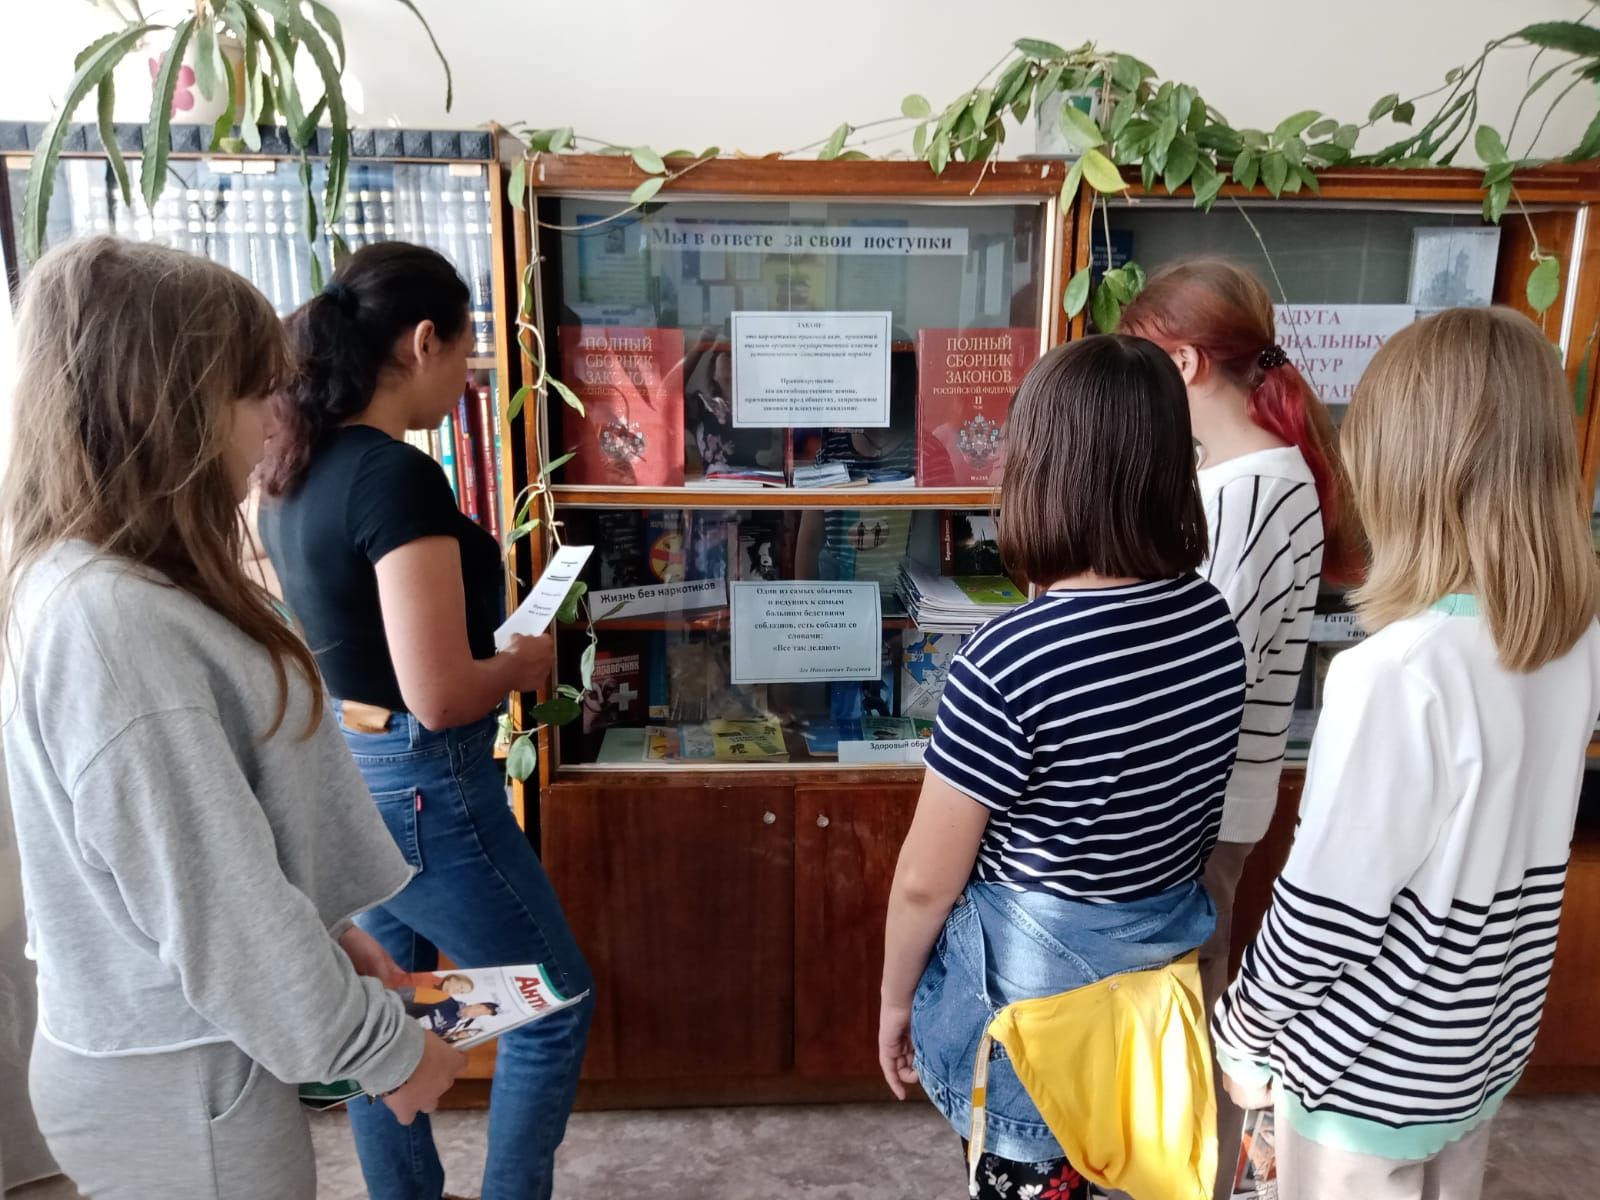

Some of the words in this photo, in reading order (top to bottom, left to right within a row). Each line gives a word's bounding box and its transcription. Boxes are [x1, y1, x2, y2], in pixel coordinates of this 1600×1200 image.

[653, 227, 687, 246] Мы
[694, 233, 705, 246] в
[710, 234, 774, 247] ответе
[784, 234, 804, 248] за
[810, 235, 851, 249] свои
[864, 235, 953, 254] поступки
[1276, 310, 1341, 327] АДУГА
[585, 336, 653, 352] ПОЛНЫЙ
[947, 335, 1013, 351] ПОЛНЫЙ
[585, 353, 653, 369] СБОРНИК
[946, 353, 1013, 368] СБОРНИК
[1294, 358, 1343, 372] ЬТУР
[946, 370, 1012, 384] ЗАКОНОВ
[933, 385, 981, 395] РОССИЙСКОЙ
[1318, 384, 1356, 399] ТАН
[600, 592, 636, 604] Жизнь
[638, 588, 656, 599] без
[658, 582, 716, 598] наркотиков
[756, 587, 778, 595] Один
[816, 587, 854, 595] обычных
[1324, 614, 1356, 625] Татар
[1346, 630, 1368, 639] тво
[870, 741, 909, 751] Здоровый
[910, 740, 929, 749] обра
